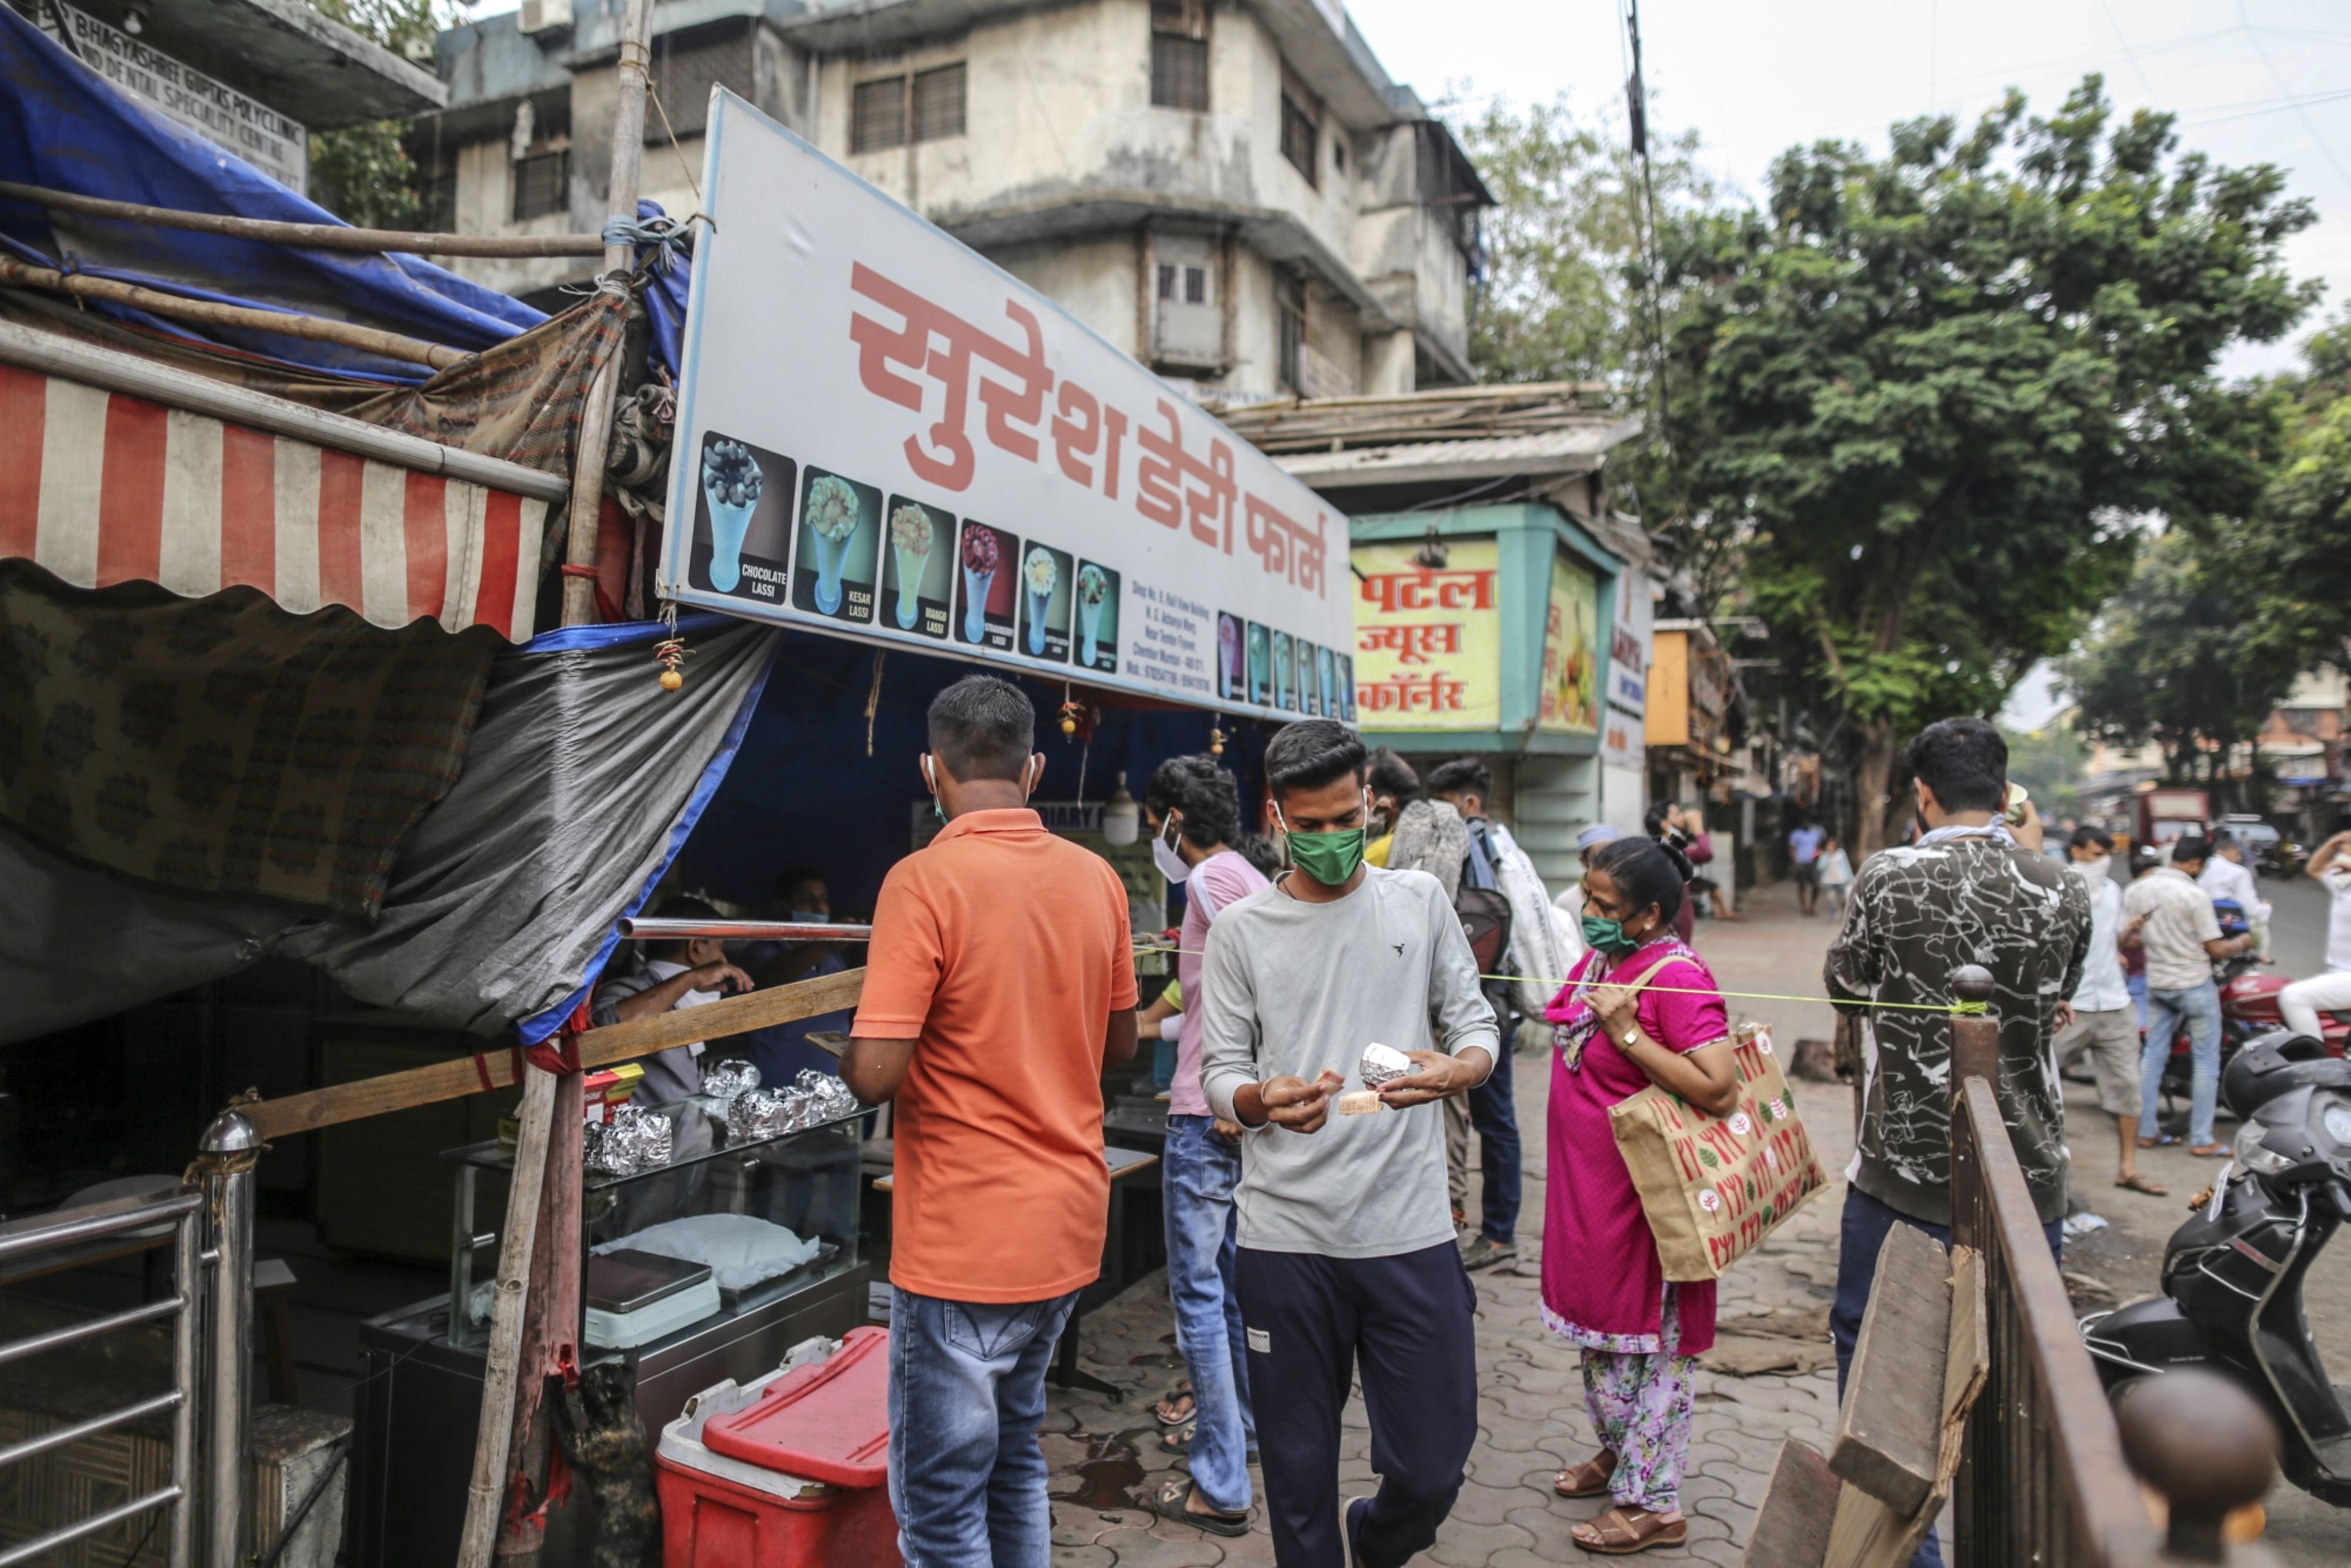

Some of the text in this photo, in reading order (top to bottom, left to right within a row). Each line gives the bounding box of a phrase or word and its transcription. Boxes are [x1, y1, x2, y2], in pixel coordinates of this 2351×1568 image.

[76, 13, 179, 85] BHAGYASHREE
[184, 70, 231, 111] GUPTAS
[233, 93, 302, 146] POLYCLINIC
[106, 56, 158, 102] DENTAL
[239, 123, 283, 162] CENTRE
[850, 260, 1328, 600] सुरेश डेरी फार्म
[742, 563, 787, 585] CHOCOLATE
[752, 581, 775, 598] LASSI
[1133, 580, 1146, 599] Shop
[1360, 560, 1498, 613] पटेल
[849, 590, 871, 605] KESAR
[849, 605, 869, 618] LASSI
[925, 607, 947, 622] MANGO
[926, 620, 944, 634] LASSI
[984, 622, 1014, 636] STRAWBERRY
[1146, 625, 1158, 640] Near
[992, 635, 1007, 646] LASSI
[1357, 623, 1462, 665] ज्यूस
[1133, 641, 1158, 660] Chembur
[1160, 648, 1180, 667] Mumbai
[1357, 671, 1466, 713] कॉर्नर
